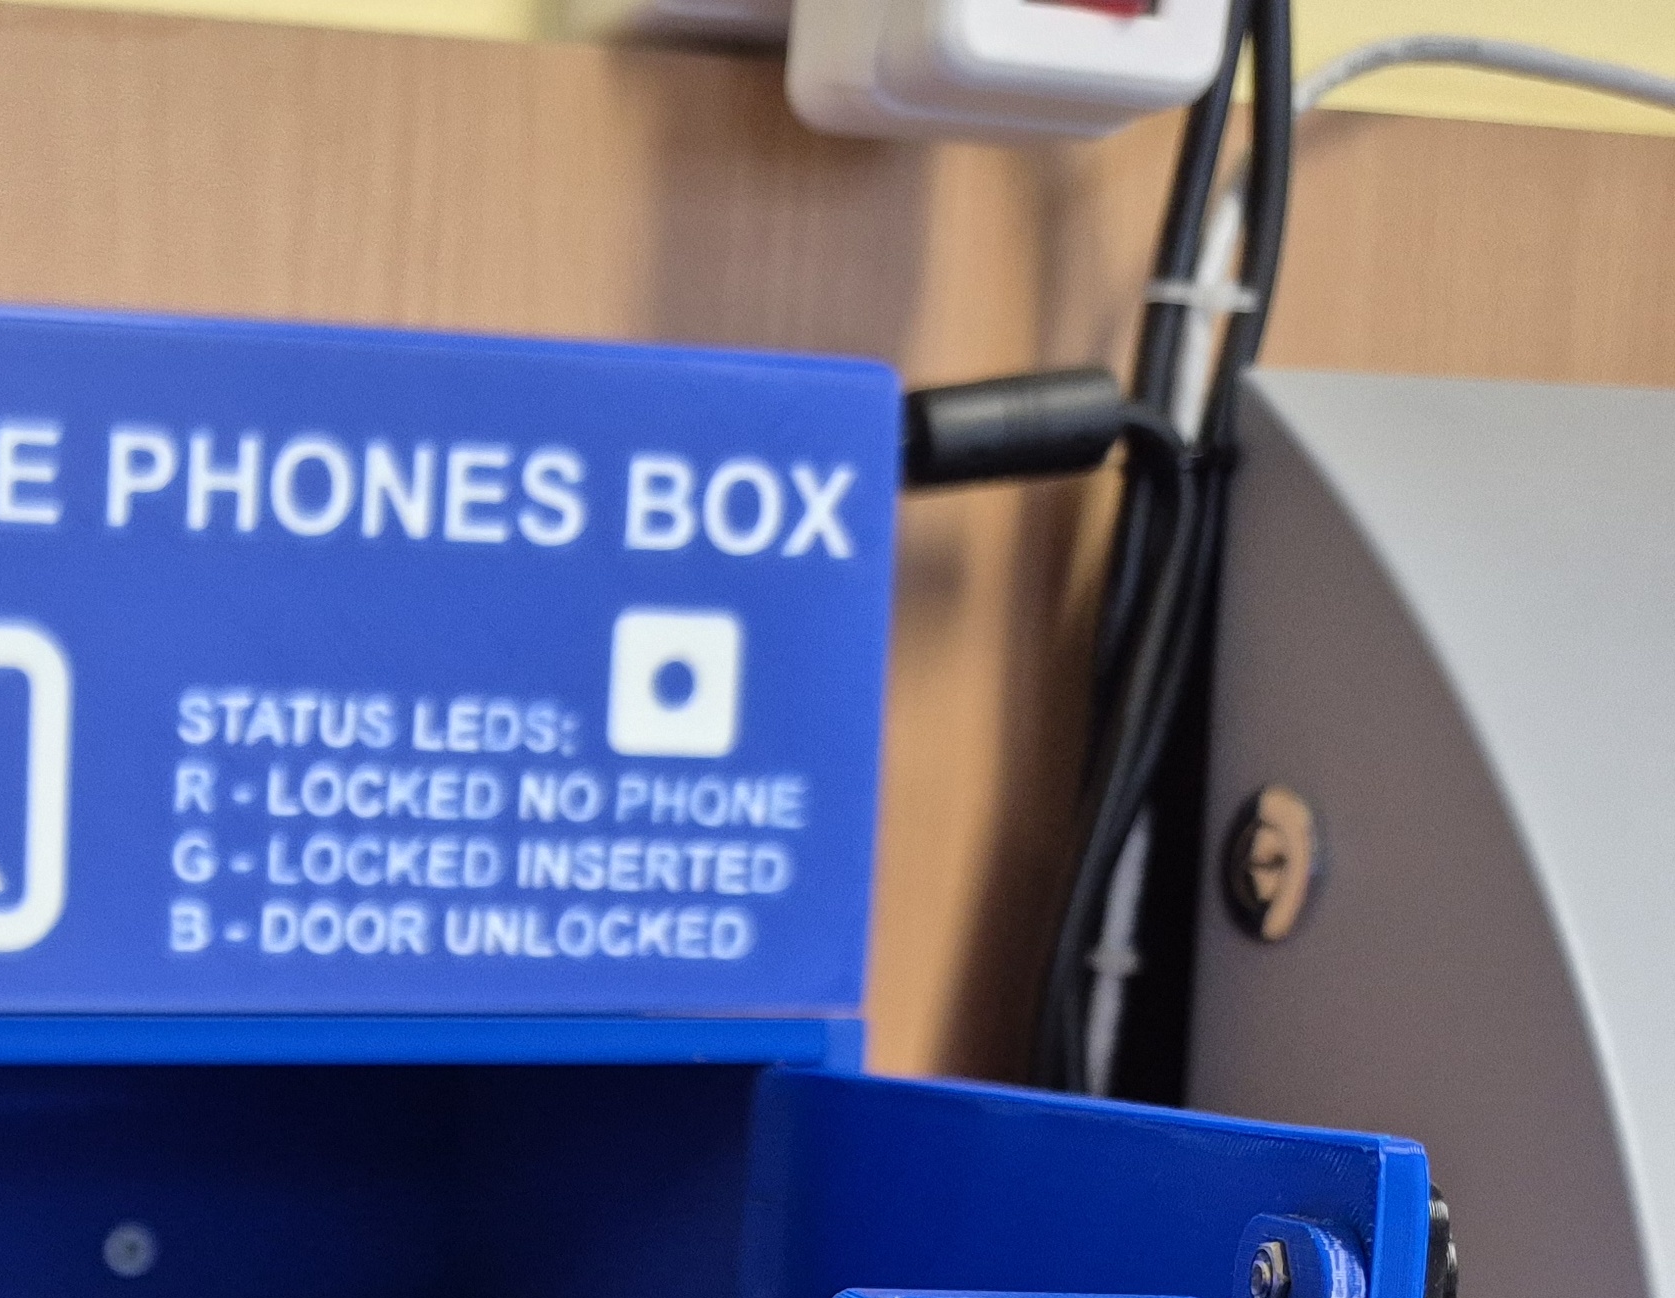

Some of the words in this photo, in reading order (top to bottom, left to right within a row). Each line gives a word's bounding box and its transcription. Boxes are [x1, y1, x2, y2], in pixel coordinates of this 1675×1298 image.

[107, 428, 585, 545] PHONES
[626, 457, 854, 557] BOX
[177, 690, 395, 749] STATUS
[413, 698, 579, 758] LEDS:
[174, 763, 215, 813] R
[266, 763, 503, 820] LOCKED
[519, 772, 602, 822] NO
[616, 774, 806, 828] PHONE
[171, 829, 218, 884] G
[267, 831, 501, 888] LOCKED
[517, 838, 791, 895] INSERTED
[170, 898, 212, 953] B
[260, 899, 429, 955] DOOR
[444, 907, 752, 961] UNLOCKED
